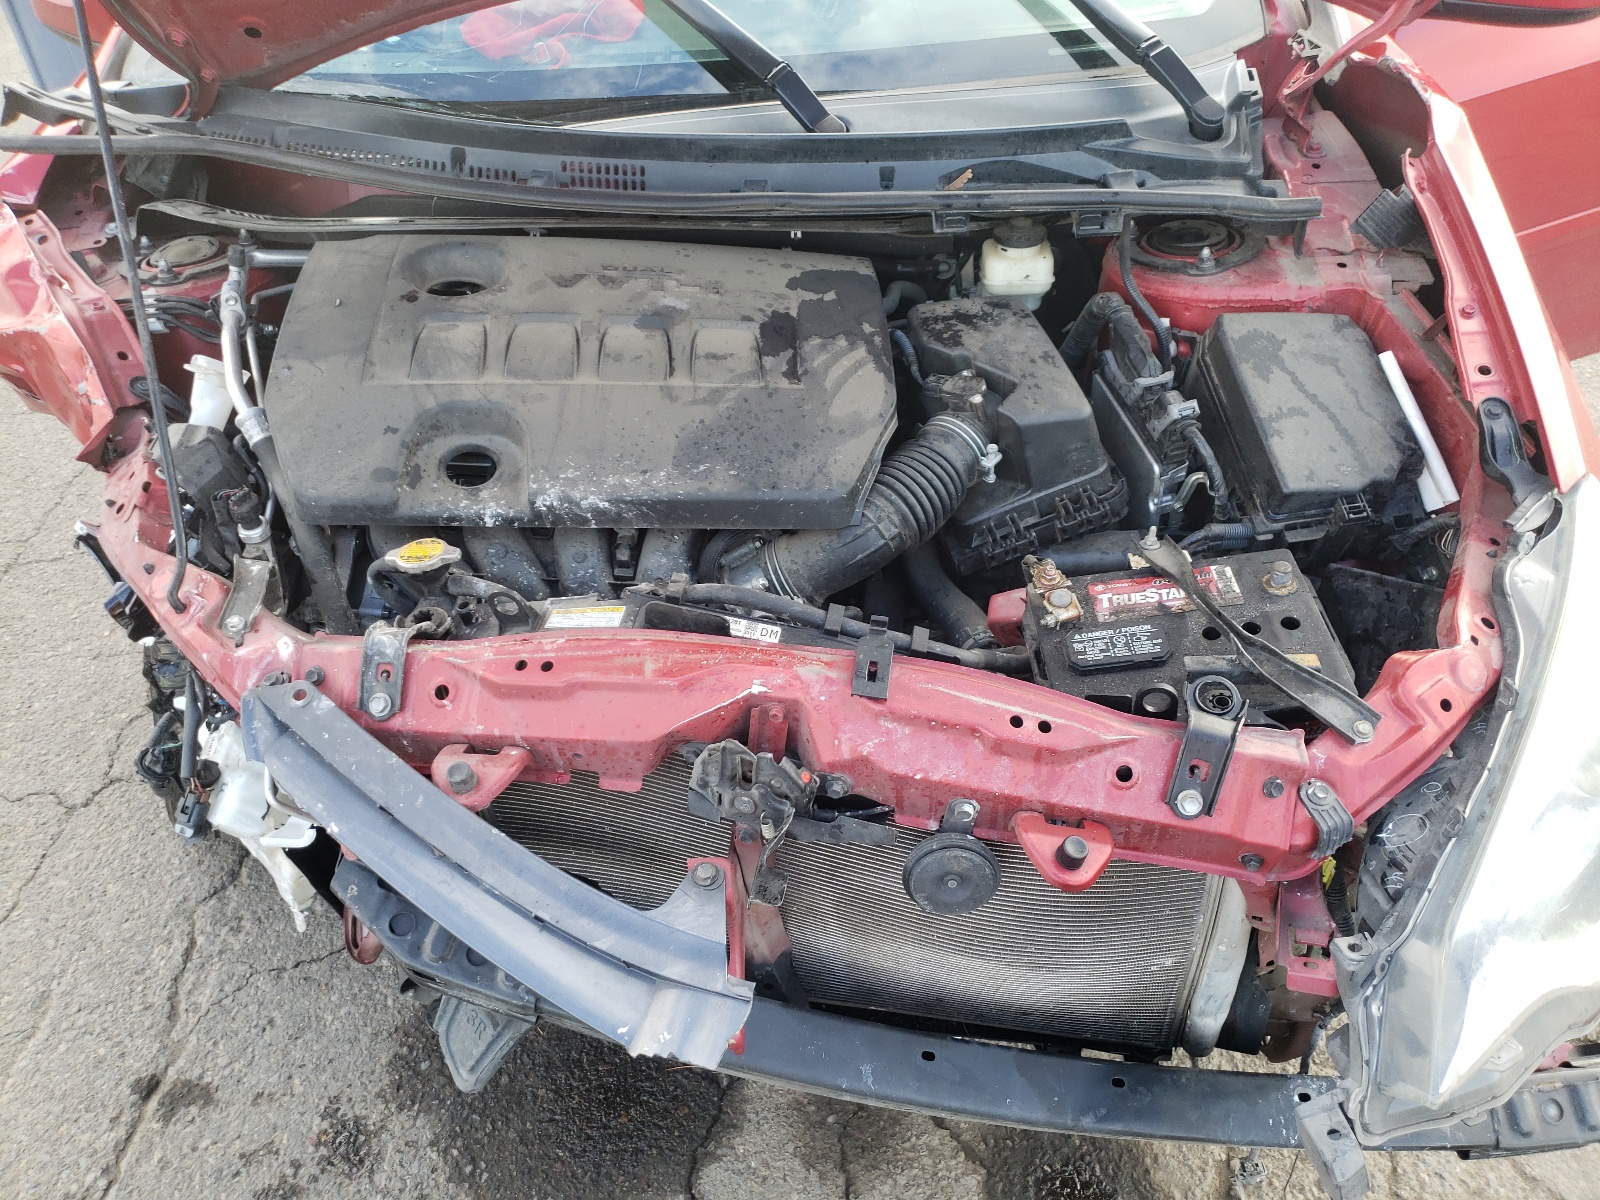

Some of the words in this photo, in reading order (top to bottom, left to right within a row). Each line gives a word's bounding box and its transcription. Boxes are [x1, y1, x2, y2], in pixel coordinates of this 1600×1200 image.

[760, 627, 779, 639] DM
[1081, 629, 1114, 639] DANGER
[1121, 624, 1152, 633] POISON
